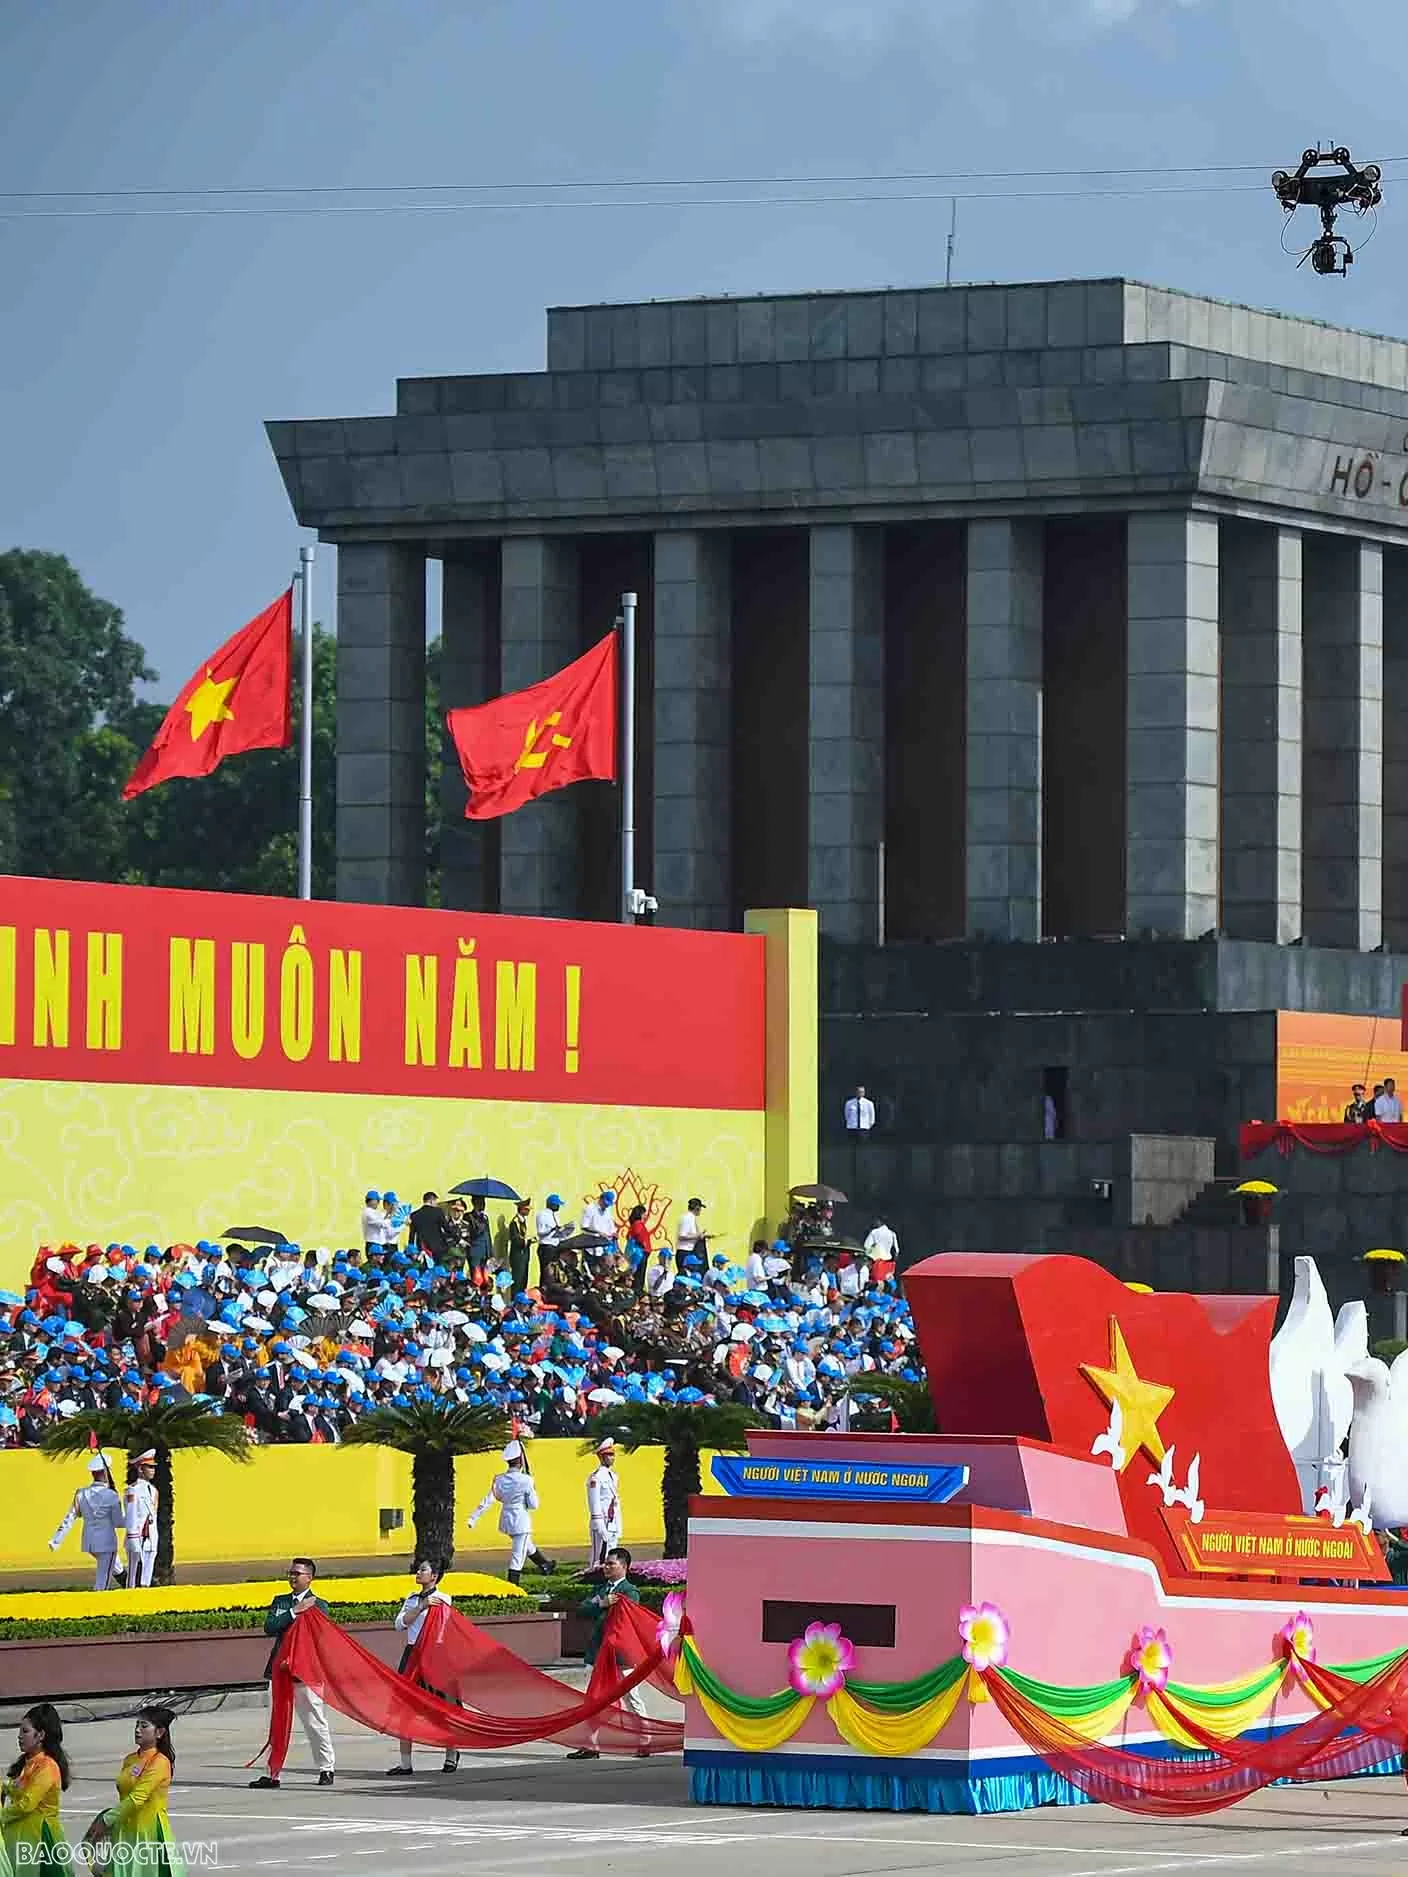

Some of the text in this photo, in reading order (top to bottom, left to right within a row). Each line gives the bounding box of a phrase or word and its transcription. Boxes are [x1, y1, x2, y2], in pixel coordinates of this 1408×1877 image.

[170, 924, 362, 1063] MUÔN
[404, 938, 537, 1072] NĂM
[743, 1466, 780, 1481] NGƯỜI
[784, 1466, 809, 1484] VIỆT
[812, 1469, 840, 1484] NAM
[855, 1470, 889, 1486] NƯỚC
[892, 1472, 929, 1488] NGOÀI
[1202, 1530, 1233, 1553] NGƯỜI
[1235, 1532, 1257, 1557] VIỆT
[1259, 1536, 1284, 1555] NAM
[1295, 1536, 1321, 1558] NƯỚC
[1323, 1537, 1353, 1559] NGOÀI
